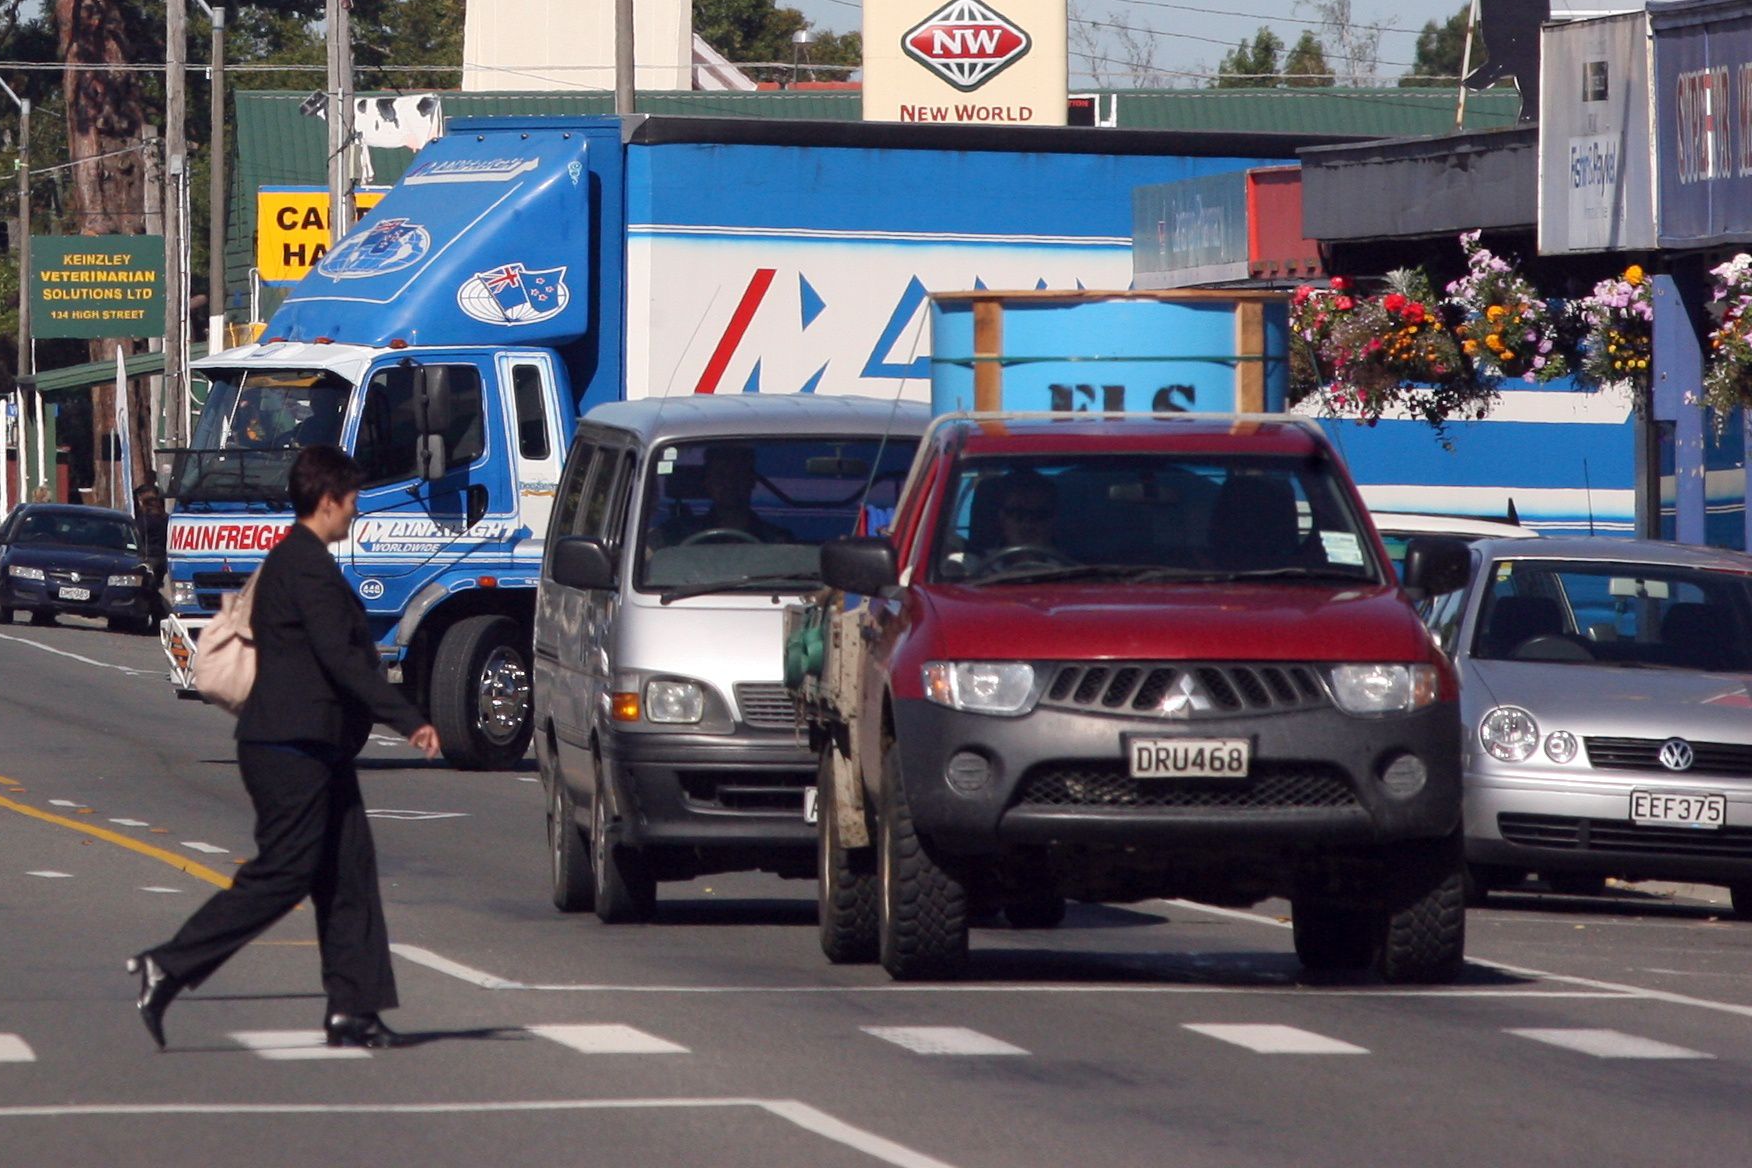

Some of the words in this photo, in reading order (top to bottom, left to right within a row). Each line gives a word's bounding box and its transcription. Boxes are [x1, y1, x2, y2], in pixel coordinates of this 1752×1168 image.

[932, 29, 1002, 55] NW
[63, 254, 132, 266] KEINZLEY
[40, 270, 156, 282] VETERINARIAN
[42, 288, 123, 300] SOLUTIONS
[127, 288, 153, 300] LTD
[72, 310, 100, 319] HIGH
[102, 310, 145, 320] STREET
[371, 543, 441, 552] WORLDWIDE
[1137, 747, 1243, 772] DRU468
[1634, 796, 1721, 822] EEF375
